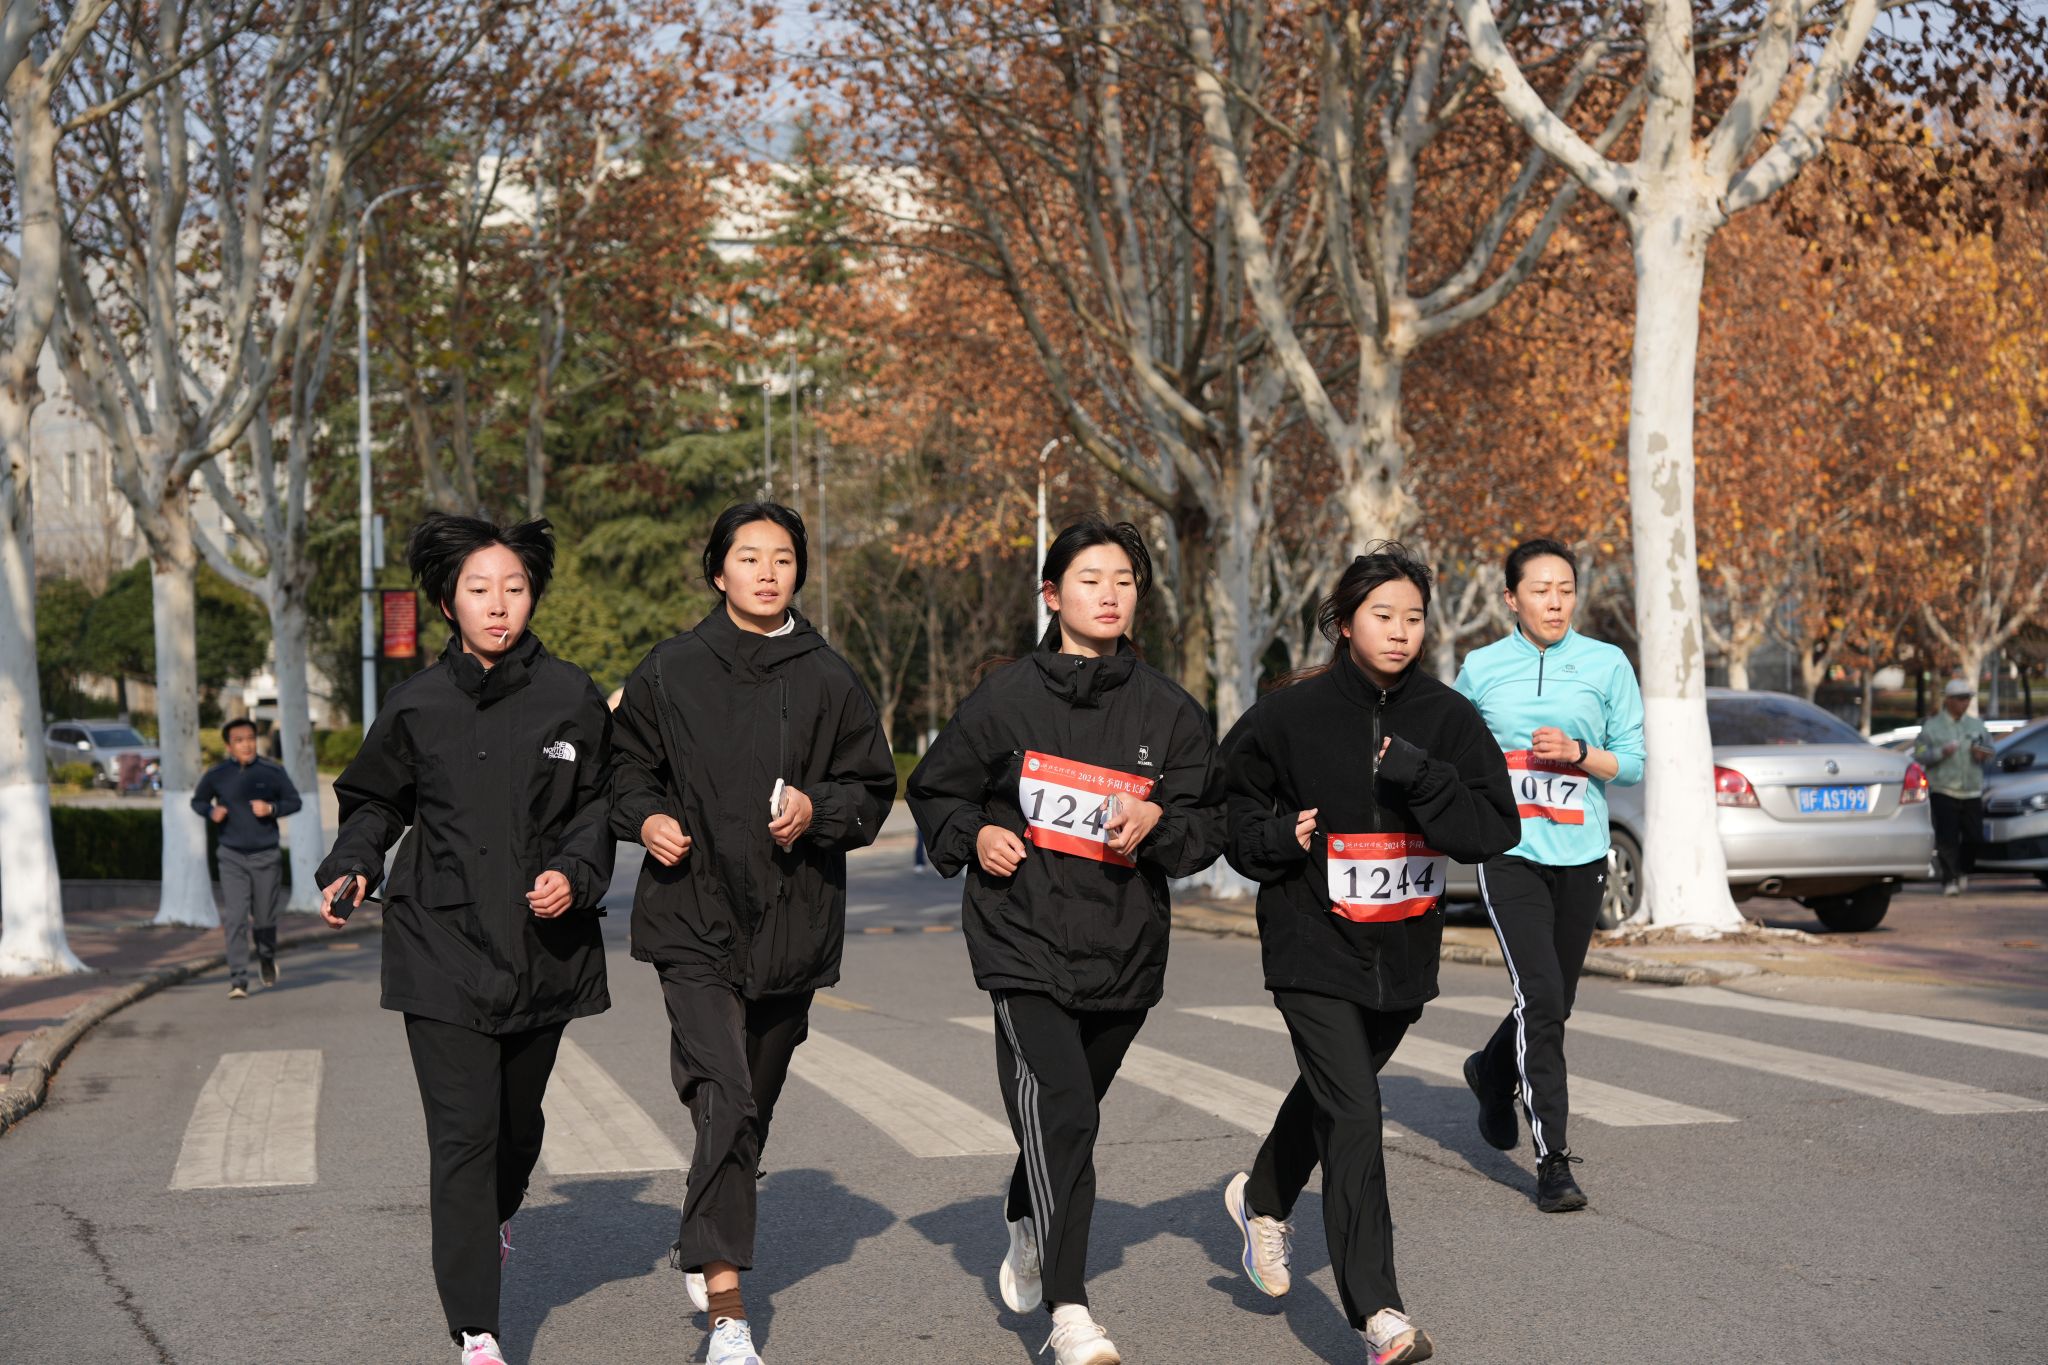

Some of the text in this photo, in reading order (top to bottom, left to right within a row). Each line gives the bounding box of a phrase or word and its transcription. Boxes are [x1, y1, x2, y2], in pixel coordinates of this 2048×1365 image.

[543, 746, 565, 754] NORTH
[1509, 775, 1578, 805] 017
[1343, 861, 1435, 899] 1244
